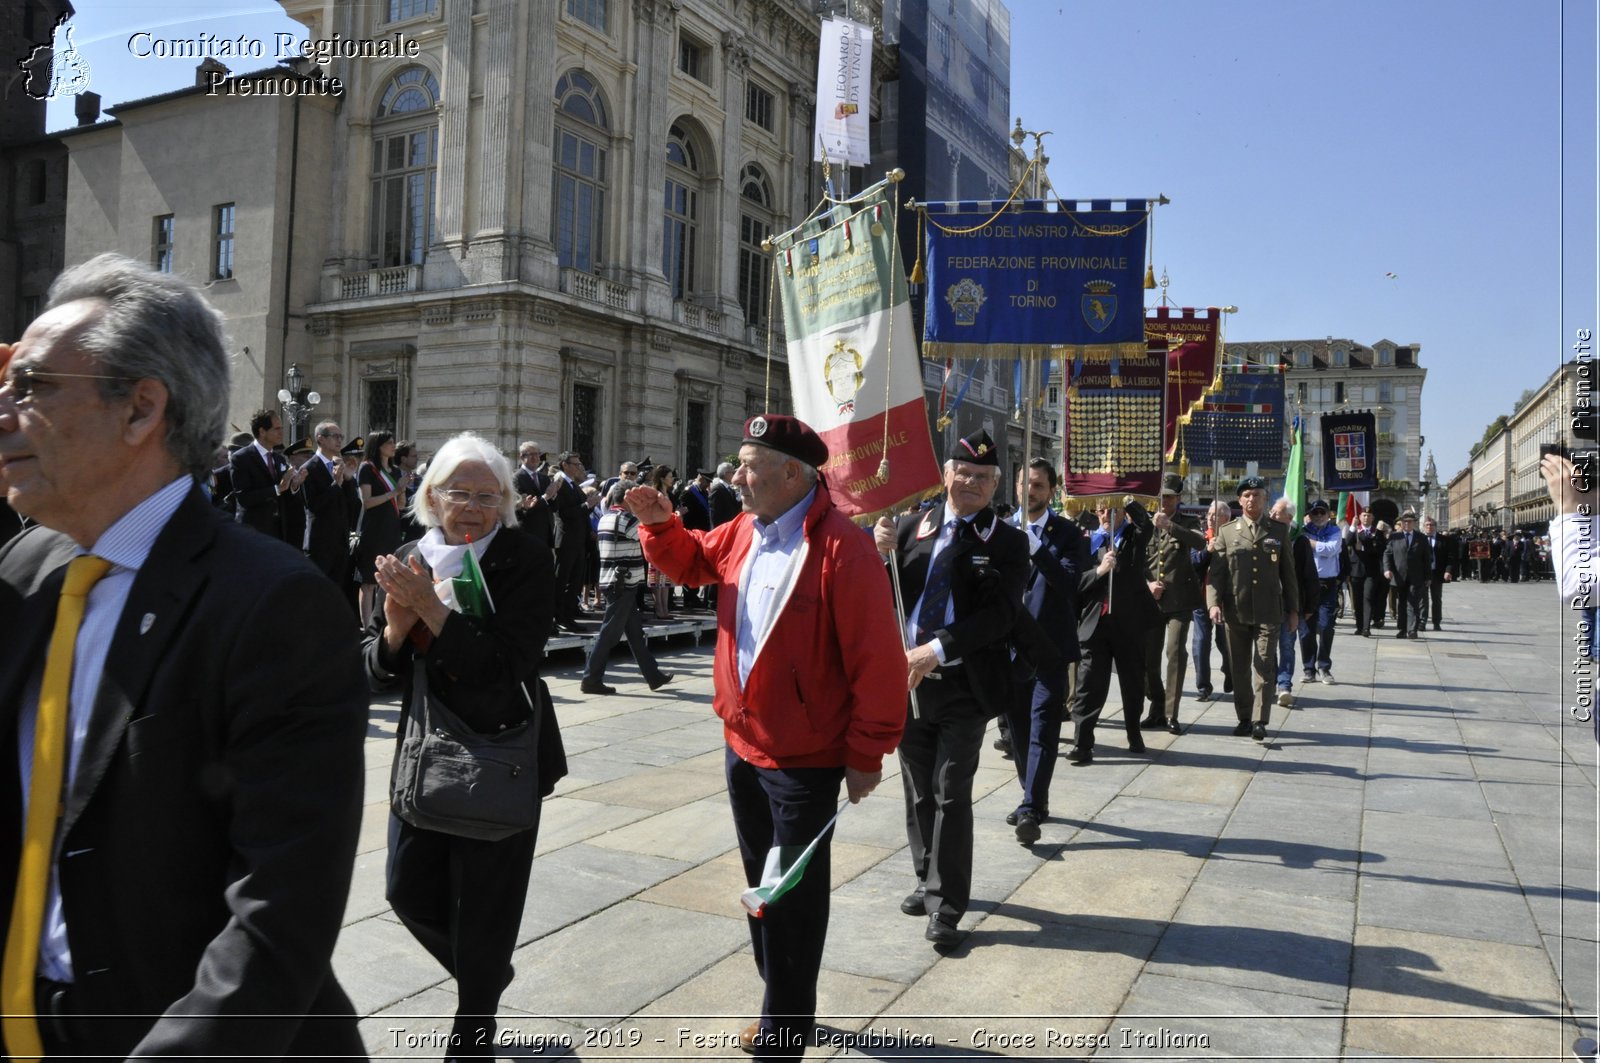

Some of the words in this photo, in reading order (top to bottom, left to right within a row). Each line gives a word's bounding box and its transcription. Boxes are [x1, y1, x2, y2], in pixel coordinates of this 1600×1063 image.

[836, 24, 850, 99] LEONARDO
[851, 43, 862, 80] VINCI
[850, 85, 860, 103] DA
[942, 225, 993, 238] ISTITUTO
[995, 225, 1016, 238] DEL
[1018, 225, 1068, 238] NASTRO
[1072, 225, 1129, 238] AZZURRO
[948, 257, 1036, 269] FEDERAZIONE
[1042, 257, 1128, 270] PROVINCIALE
[1027, 280, 1039, 291] DI
[1010, 295, 1057, 308] TORINO
[1170, 322, 1211, 331] NAZIONALE
